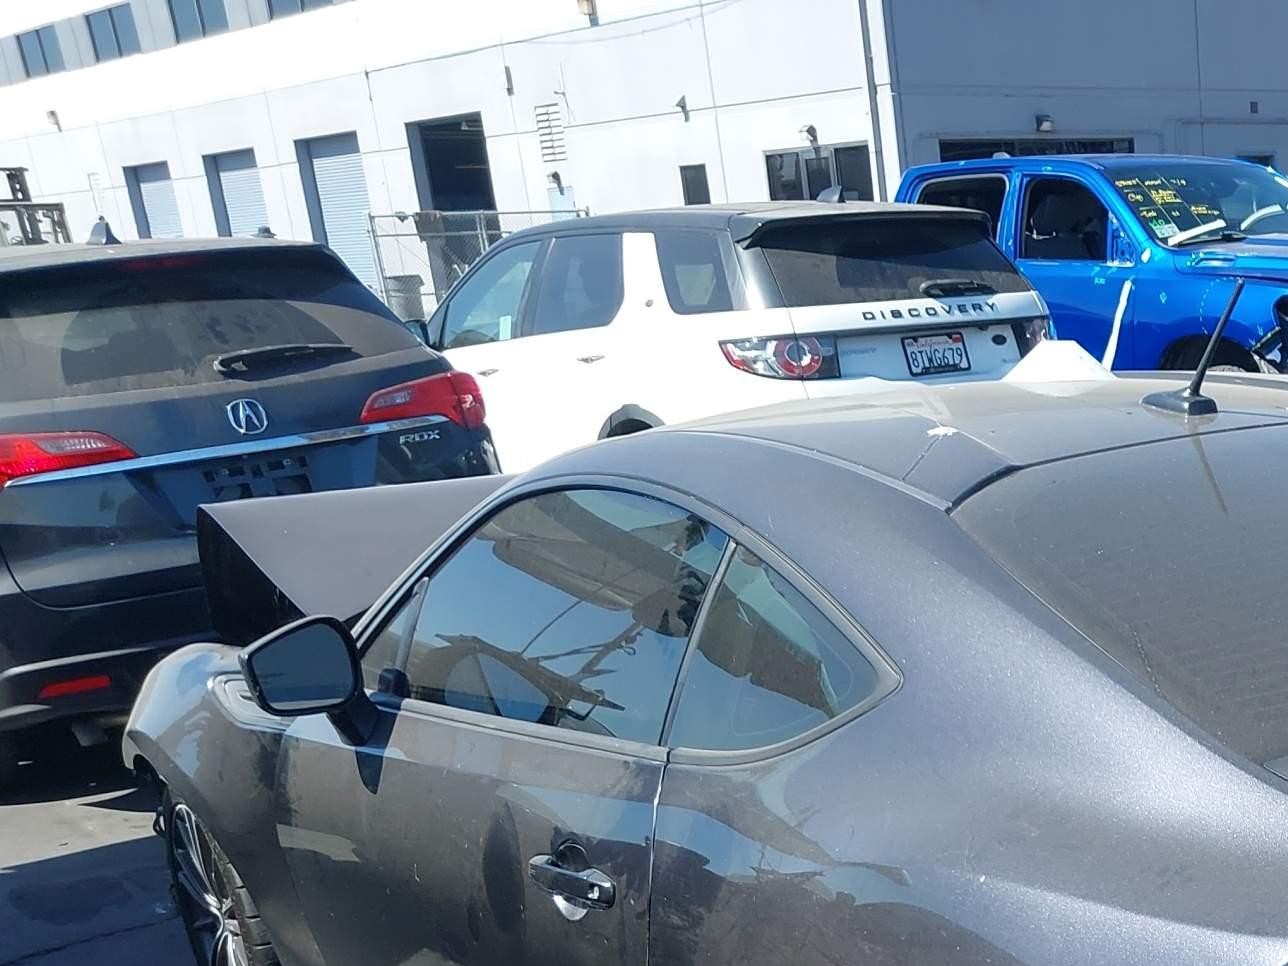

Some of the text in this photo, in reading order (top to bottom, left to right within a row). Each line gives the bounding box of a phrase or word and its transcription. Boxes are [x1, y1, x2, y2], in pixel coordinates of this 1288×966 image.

[862, 302, 998, 321] DISCOVERY
[910, 346, 964, 369] 8TWG679
[399, 430, 441, 445] RDX
